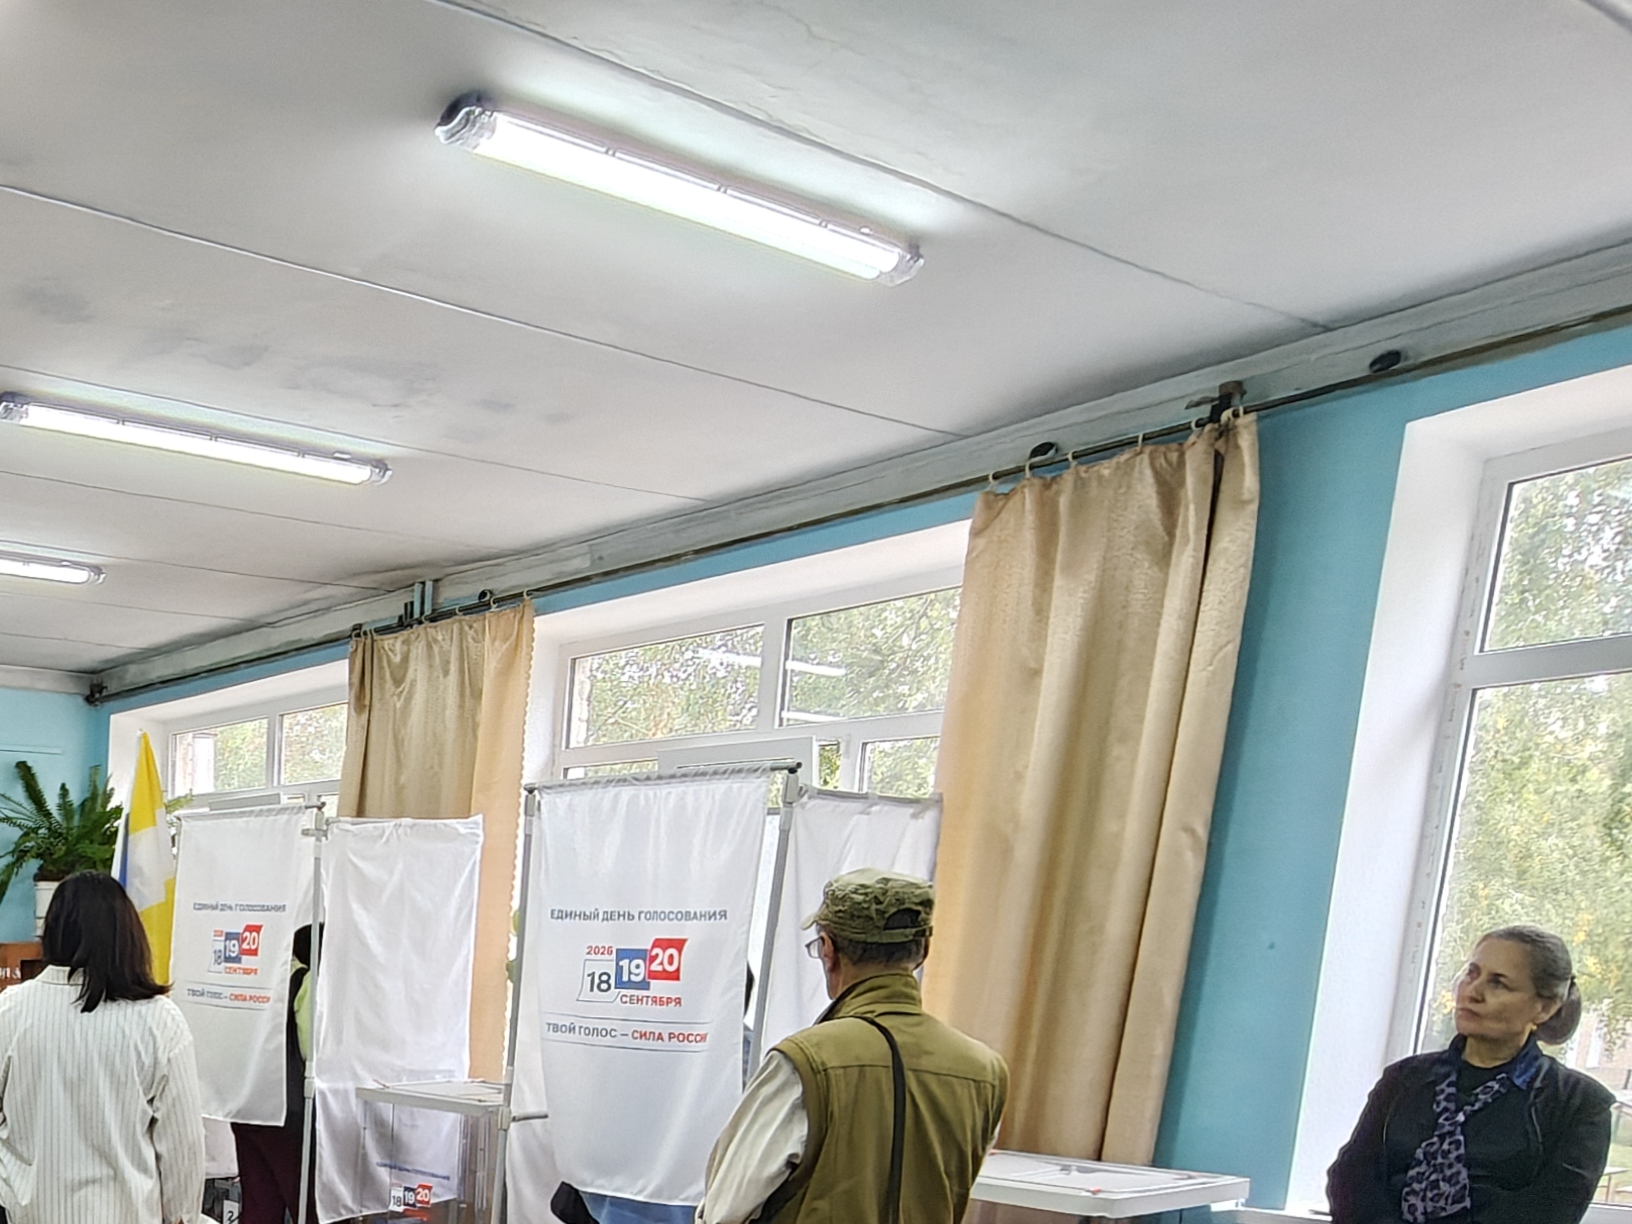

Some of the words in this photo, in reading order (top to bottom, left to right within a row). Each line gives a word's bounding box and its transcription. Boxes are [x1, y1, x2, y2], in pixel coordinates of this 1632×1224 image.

[550, 908, 599, 921] ЕДИНЫЙ
[601, 911, 635, 922] ДЕНЬ
[638, 909, 728, 922] ГОЛОСОВАНИЯ
[213, 948, 222, 966] 18
[225, 939, 239, 957] 19
[242, 931, 258, 950] 20
[585, 945, 613, 956] 2026
[586, 971, 612, 993] 18
[619, 959, 646, 982] 19
[649, 948, 679, 972] 20
[619, 994, 682, 1008] СЕНТЯБРЯ
[546, 1022, 576, 1036] ТВОЙ
[578, 1025, 617, 1038] ГОЛОС
[631, 1030, 665, 1043] СИЛА
[392, 1194, 402, 1207] 18
[404, 1191, 415, 1203] 19
[415, 1188, 429, 1201] 20
